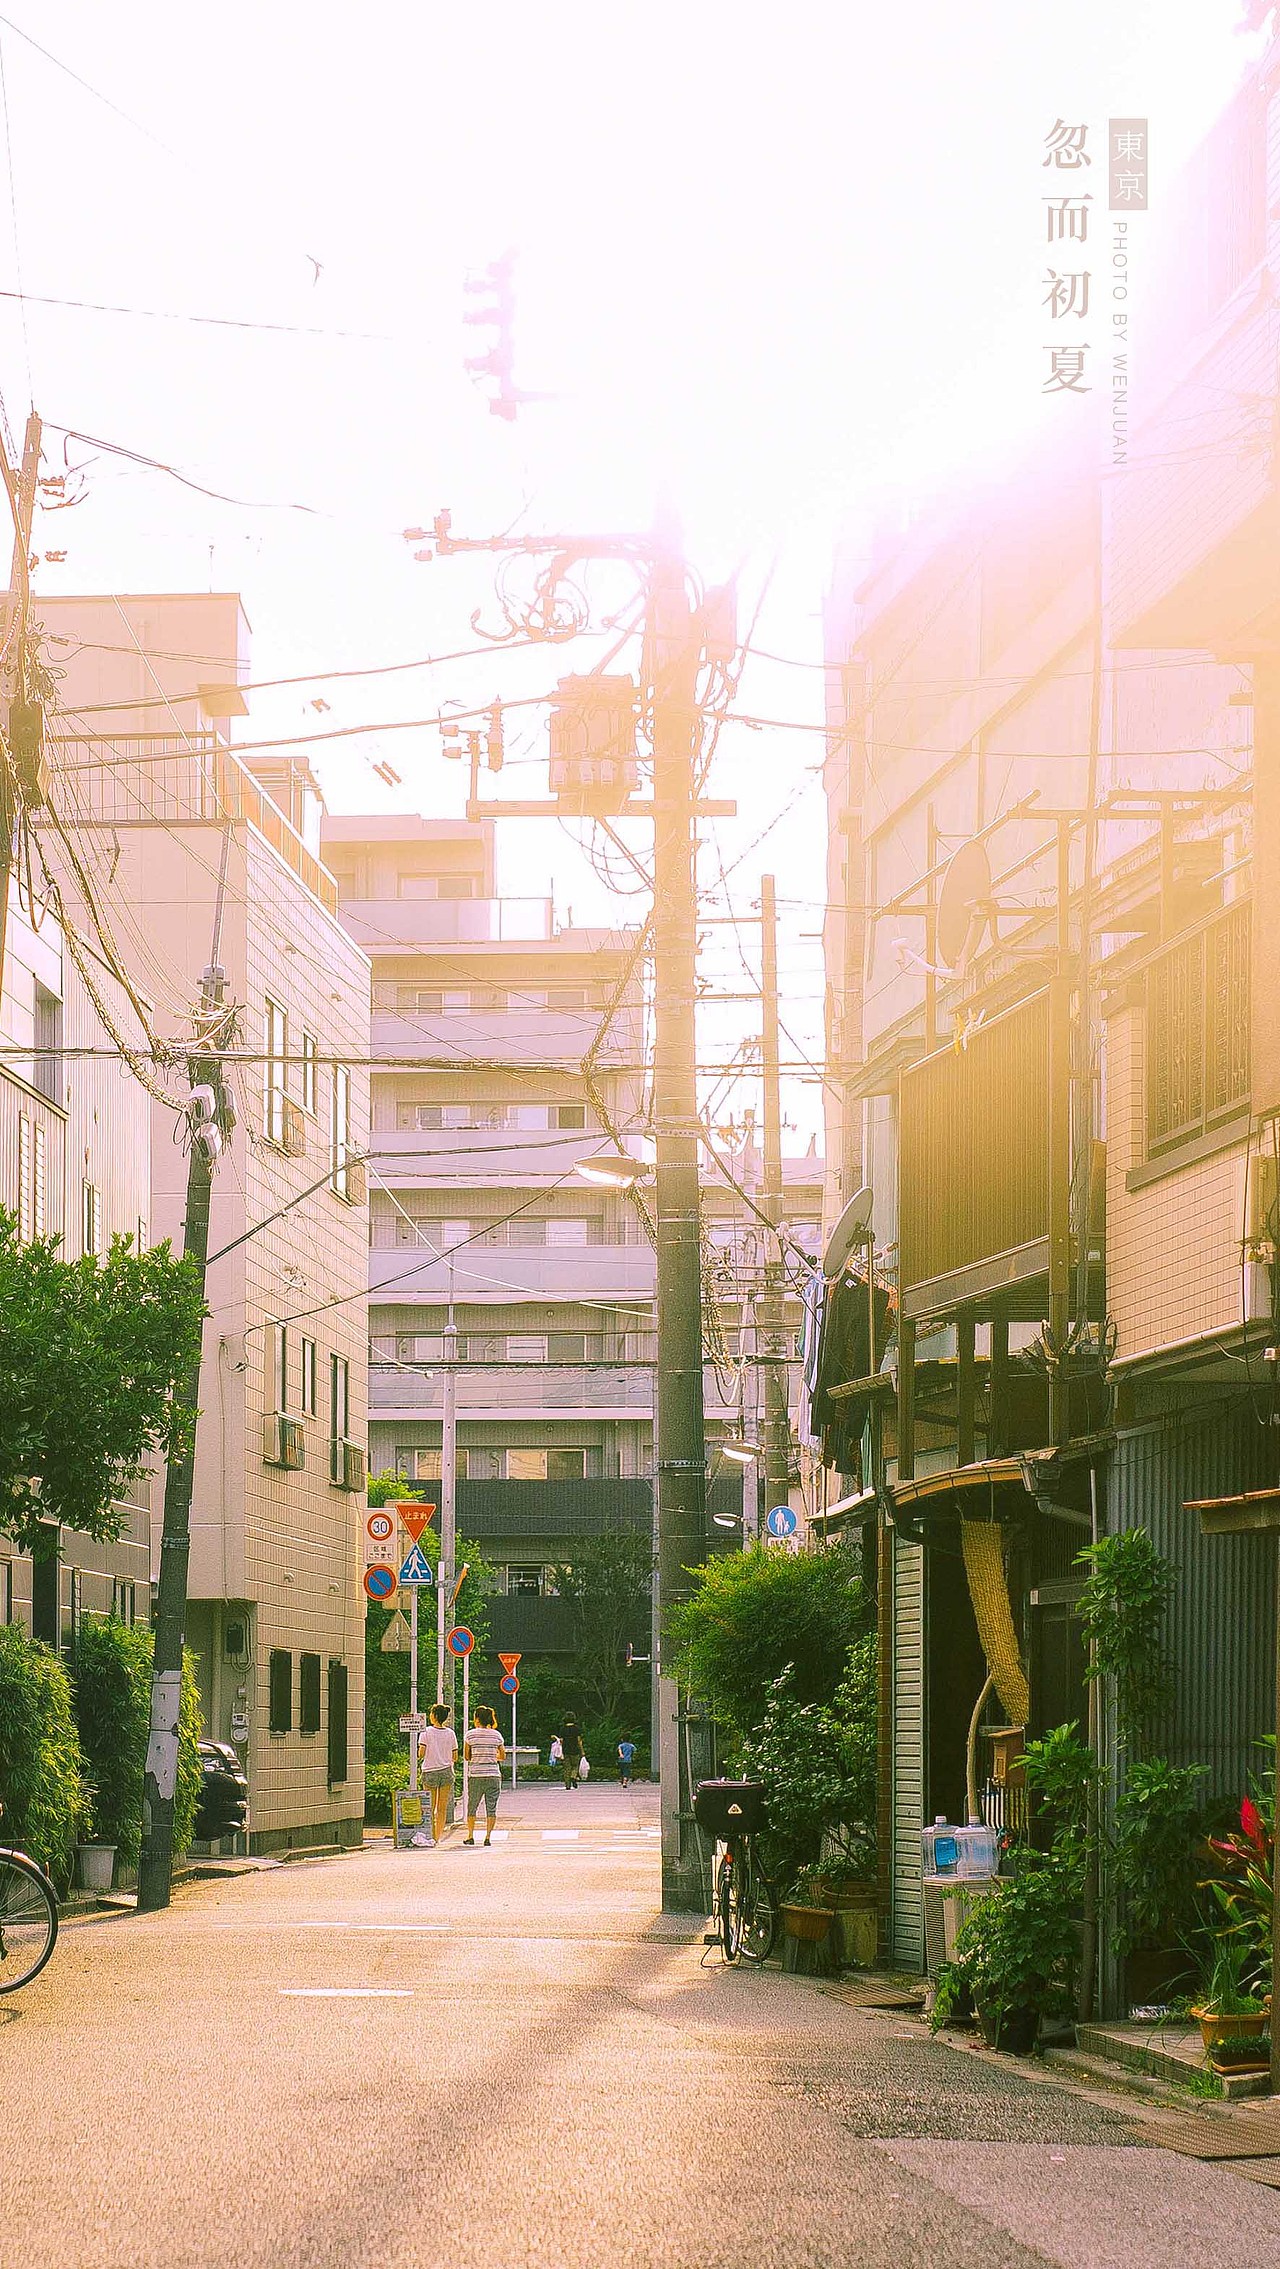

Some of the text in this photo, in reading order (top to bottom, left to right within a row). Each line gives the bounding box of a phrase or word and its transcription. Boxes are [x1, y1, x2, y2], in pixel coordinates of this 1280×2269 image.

[404, 1511, 428, 1520] 止まれ
[373, 1521, 388, 1534] 30
